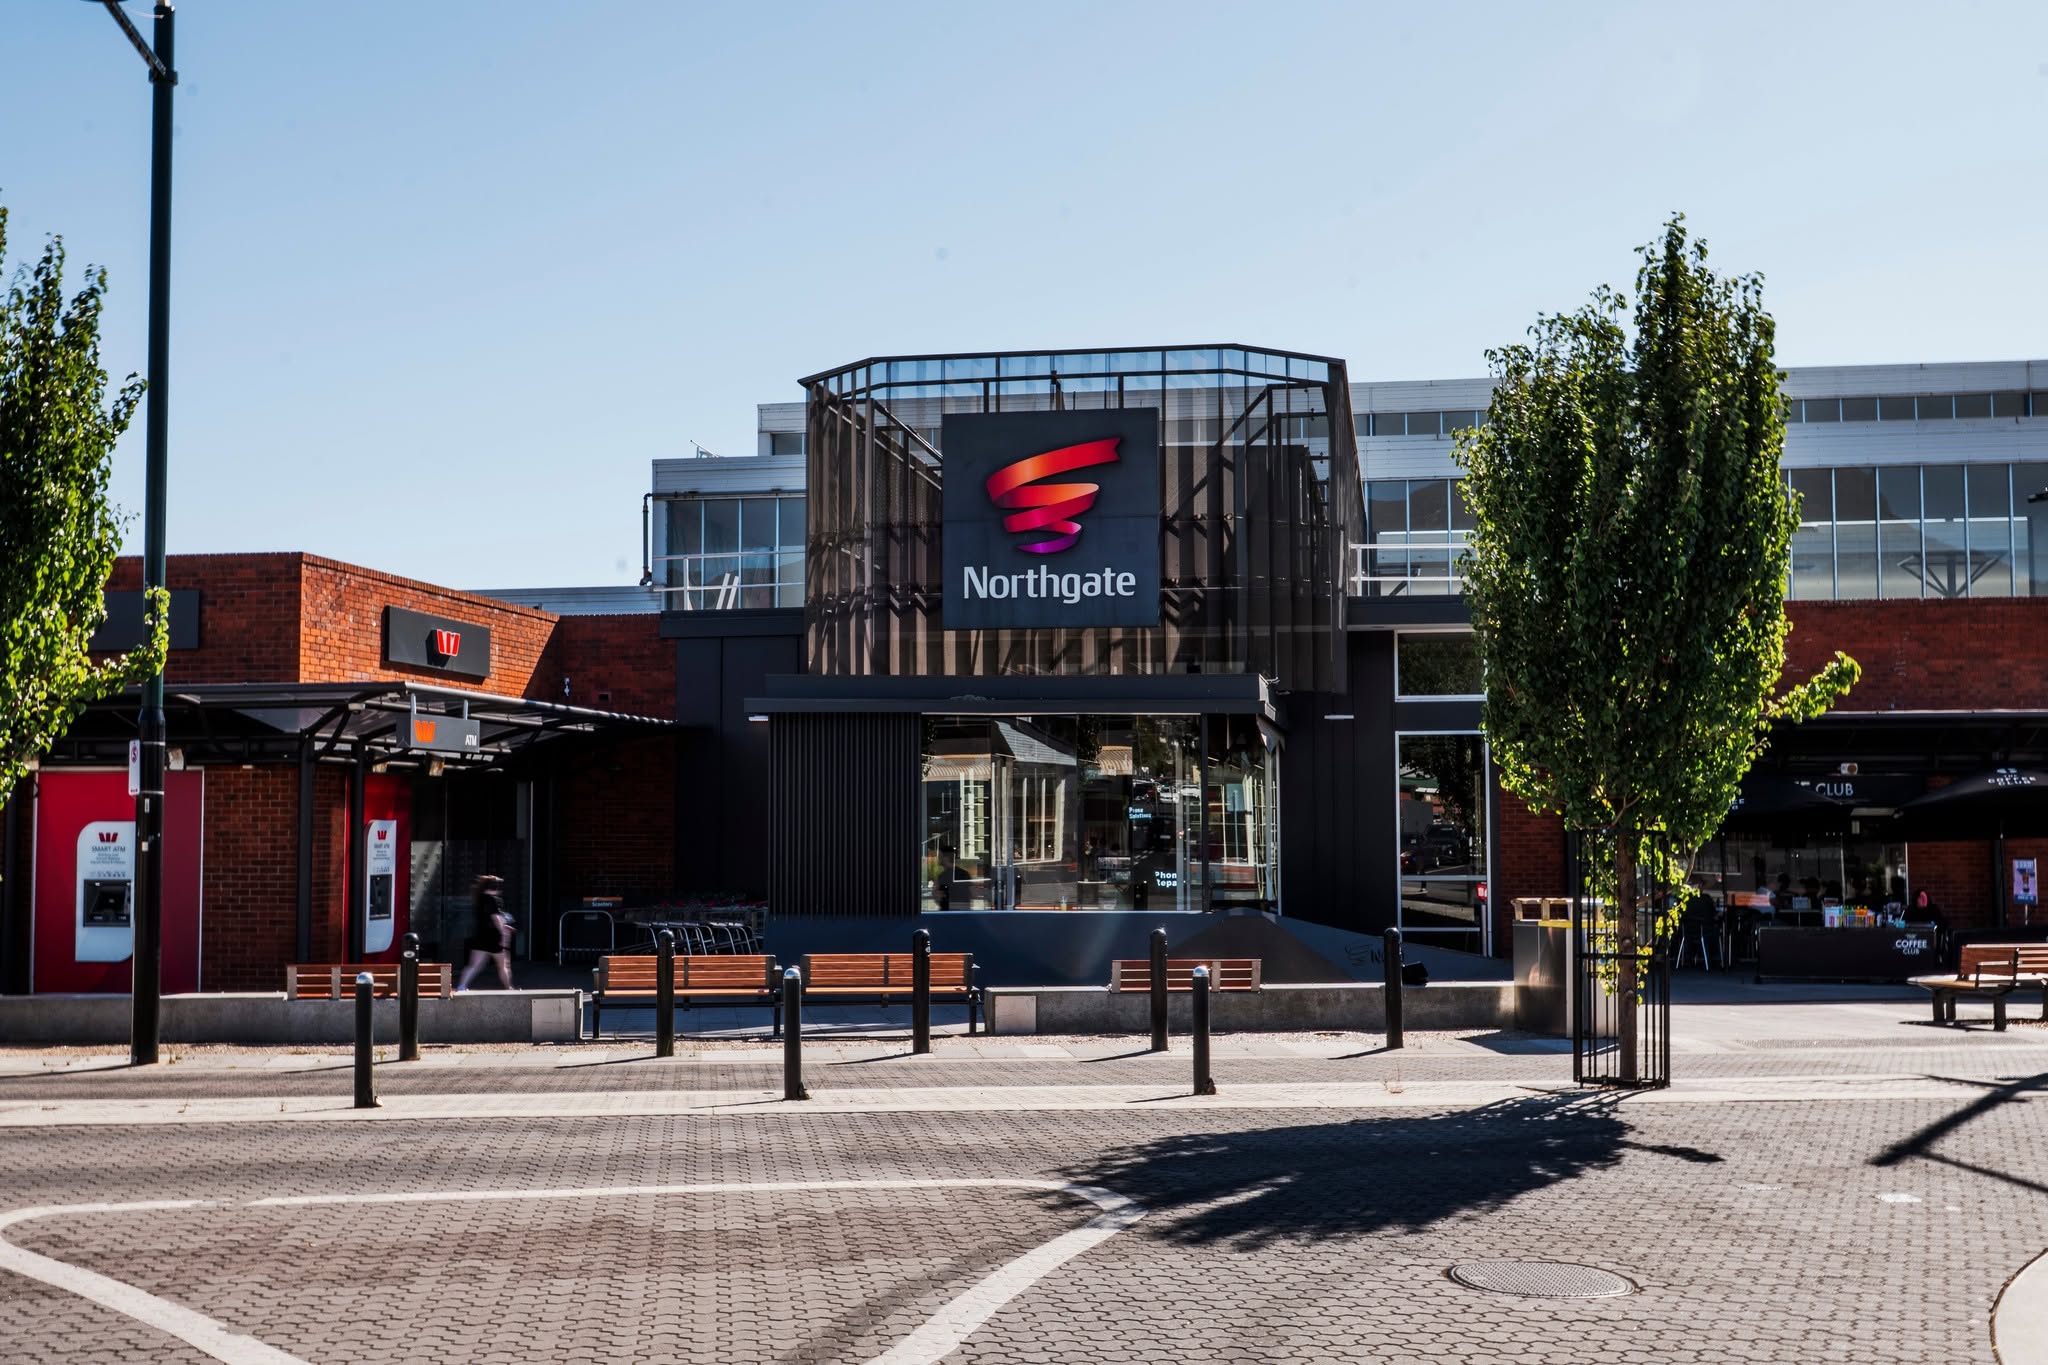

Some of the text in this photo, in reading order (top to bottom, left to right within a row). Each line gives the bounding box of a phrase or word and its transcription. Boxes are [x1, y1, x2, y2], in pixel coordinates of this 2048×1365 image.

[963, 564, 1137, 605] Northgate
[464, 734, 477, 746] ATM
[1815, 783, 1854, 796] CLUB
[1155, 871, 1177, 879] Phon
[1895, 939, 1928, 948] COFFEE
